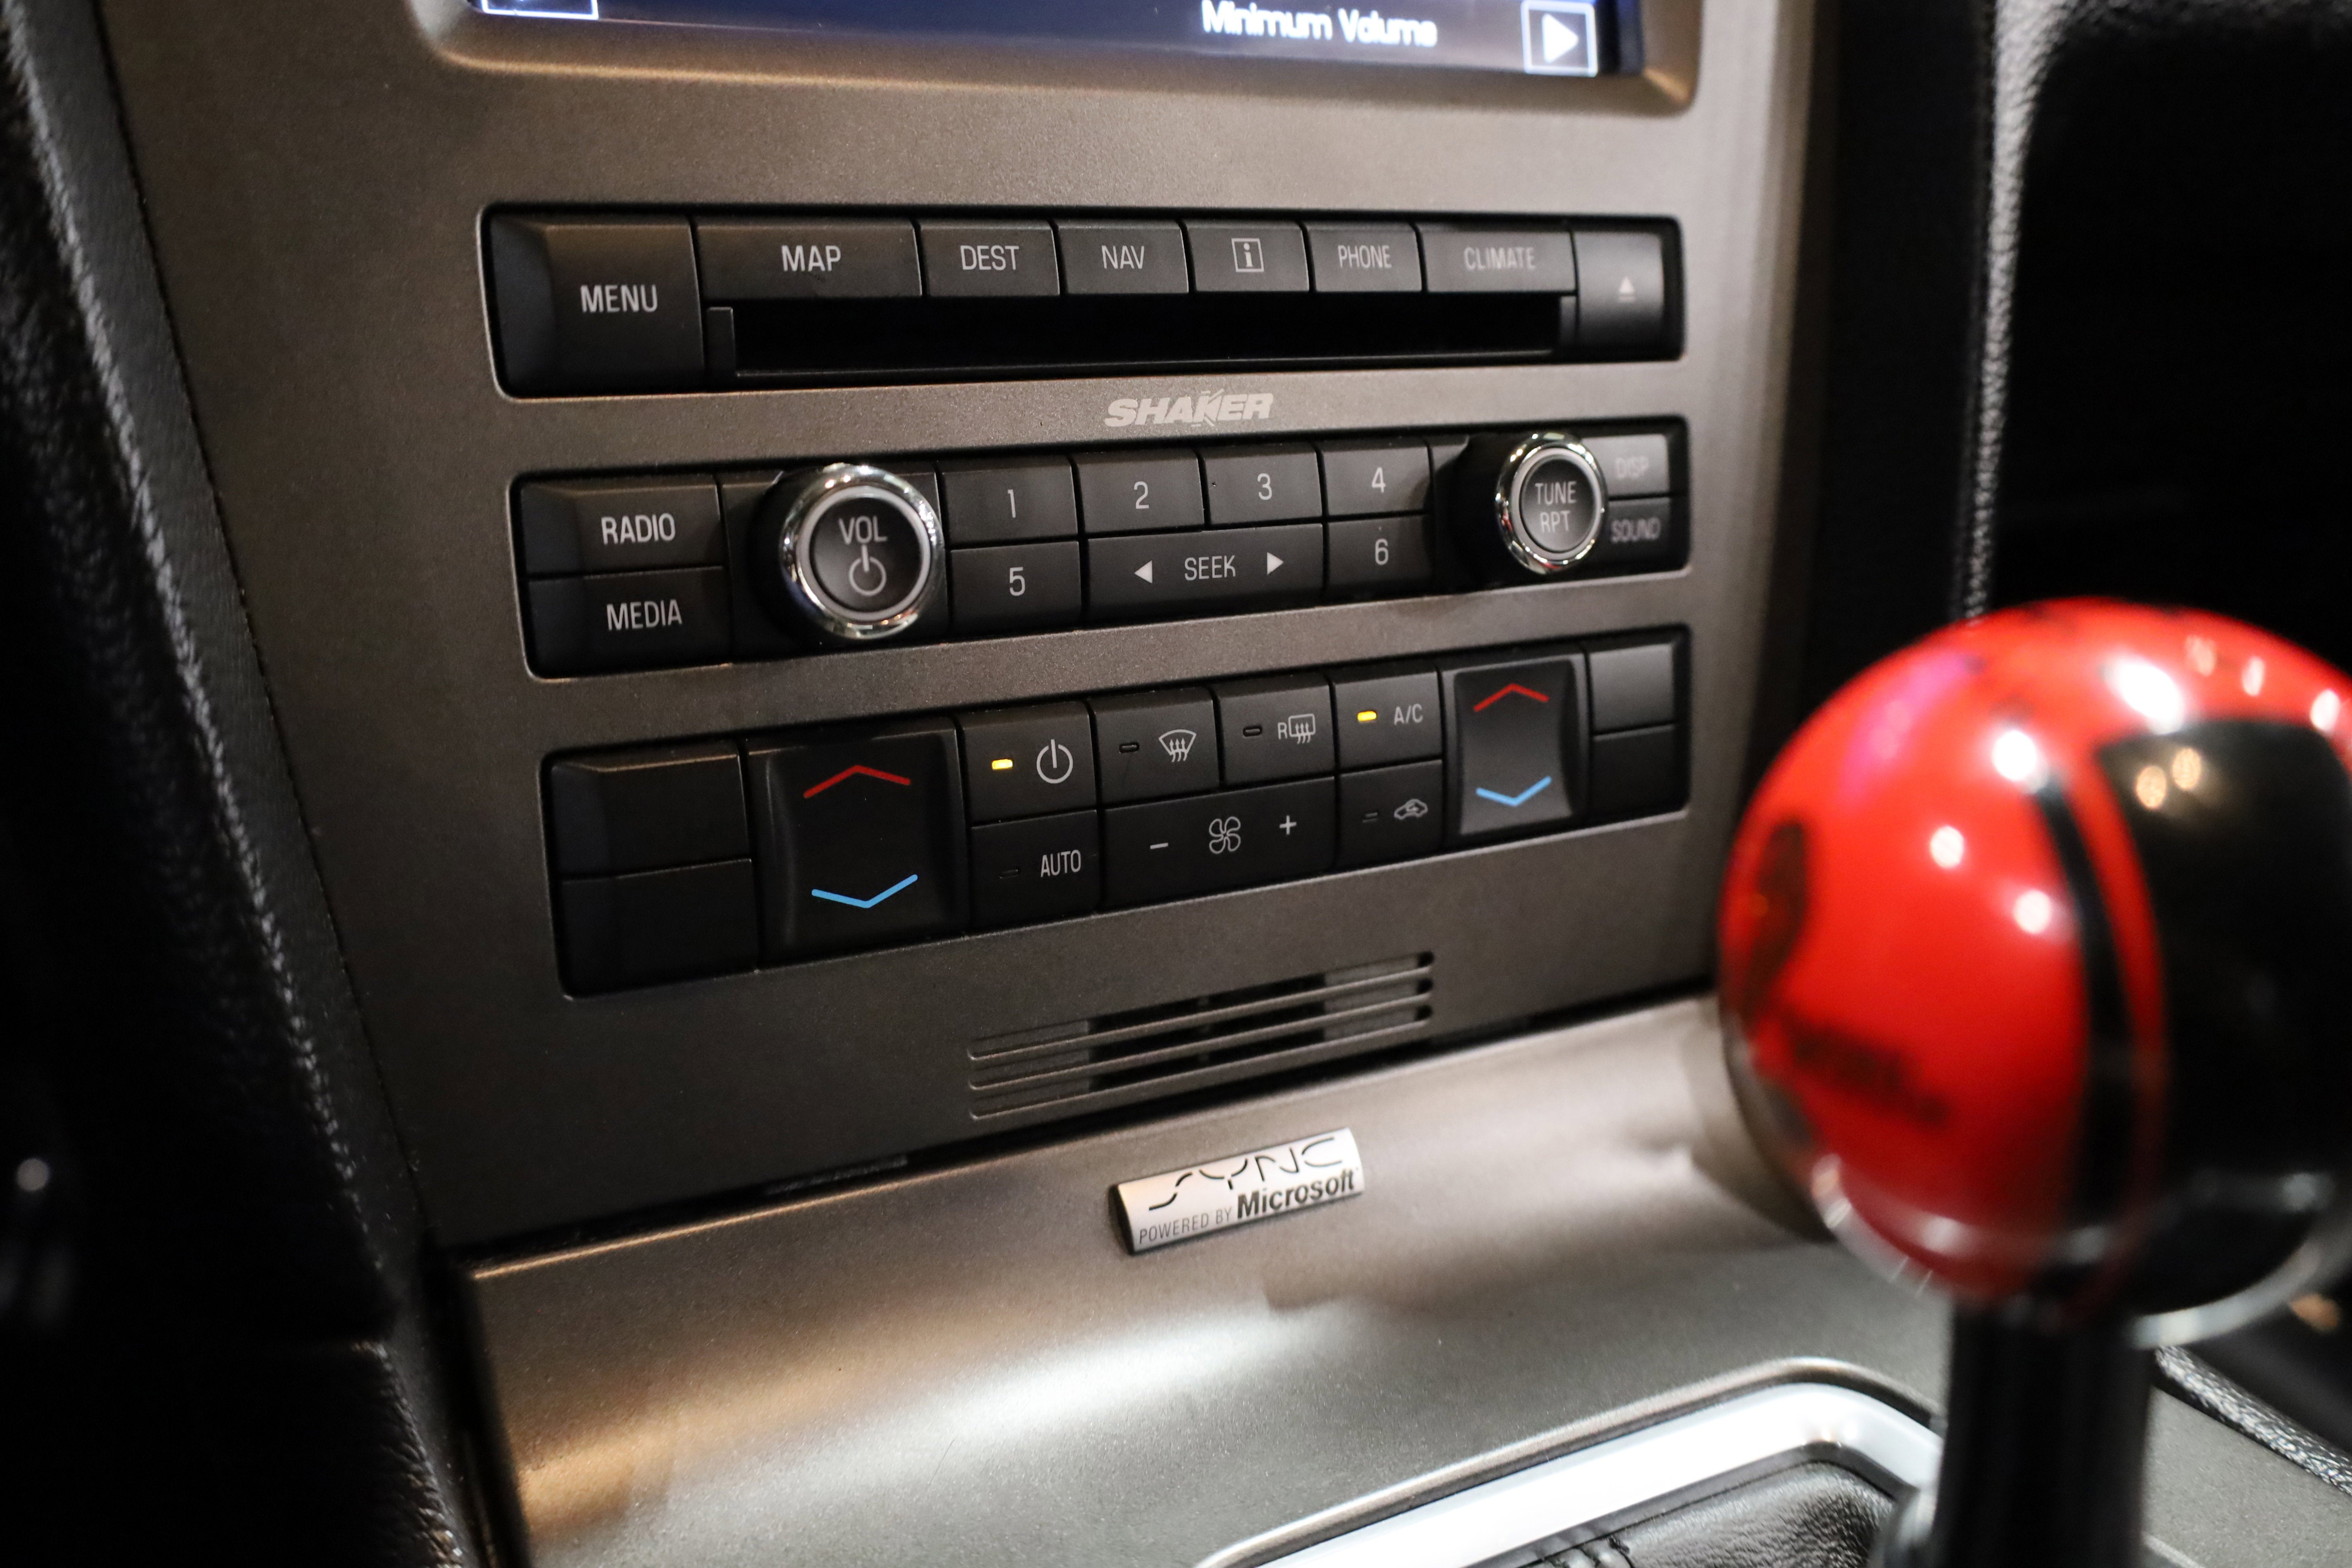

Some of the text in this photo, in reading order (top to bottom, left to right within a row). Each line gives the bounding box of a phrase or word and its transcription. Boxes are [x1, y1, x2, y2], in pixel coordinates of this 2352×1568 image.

[1202, 0, 1438, 48] Minimum Volume
[782, 245, 840, 271] MAP
[960, 245, 1019, 270] DEST
[1102, 246, 1144, 269] NAV
[1338, 245, 1392, 268] PHONE
[1464, 247, 1536, 270] CLIMATE
[581, 285, 657, 312] MENU
[1105, 388, 1274, 427] SHAKER
[1372, 467, 1385, 492] 4
[1615, 456, 1648, 479] DISP
[1134, 481, 1149, 509] 2
[1258, 473, 1272, 500] 3
[1535, 481, 1576, 505] TUNE
[1008, 490, 1016, 518] 1
[601, 513, 675, 544] RADIO
[839, 516, 887, 544] VOL
[1539, 510, 1571, 533] RPT
[1611, 517, 1661, 543] SOUND
[1375, 539, 1388, 565] 6
[1185, 555, 1236, 580] SEEK
[1010, 567, 1025, 596] 5
[607, 600, 682, 630] MEDIA
[1394, 704, 1423, 724] A/C
[1040, 849, 1081, 878] AUTO
[1148, 1137, 1343, 1211] SYNC
[1139, 1168, 1355, 1244] POWERED BY Microsoft
